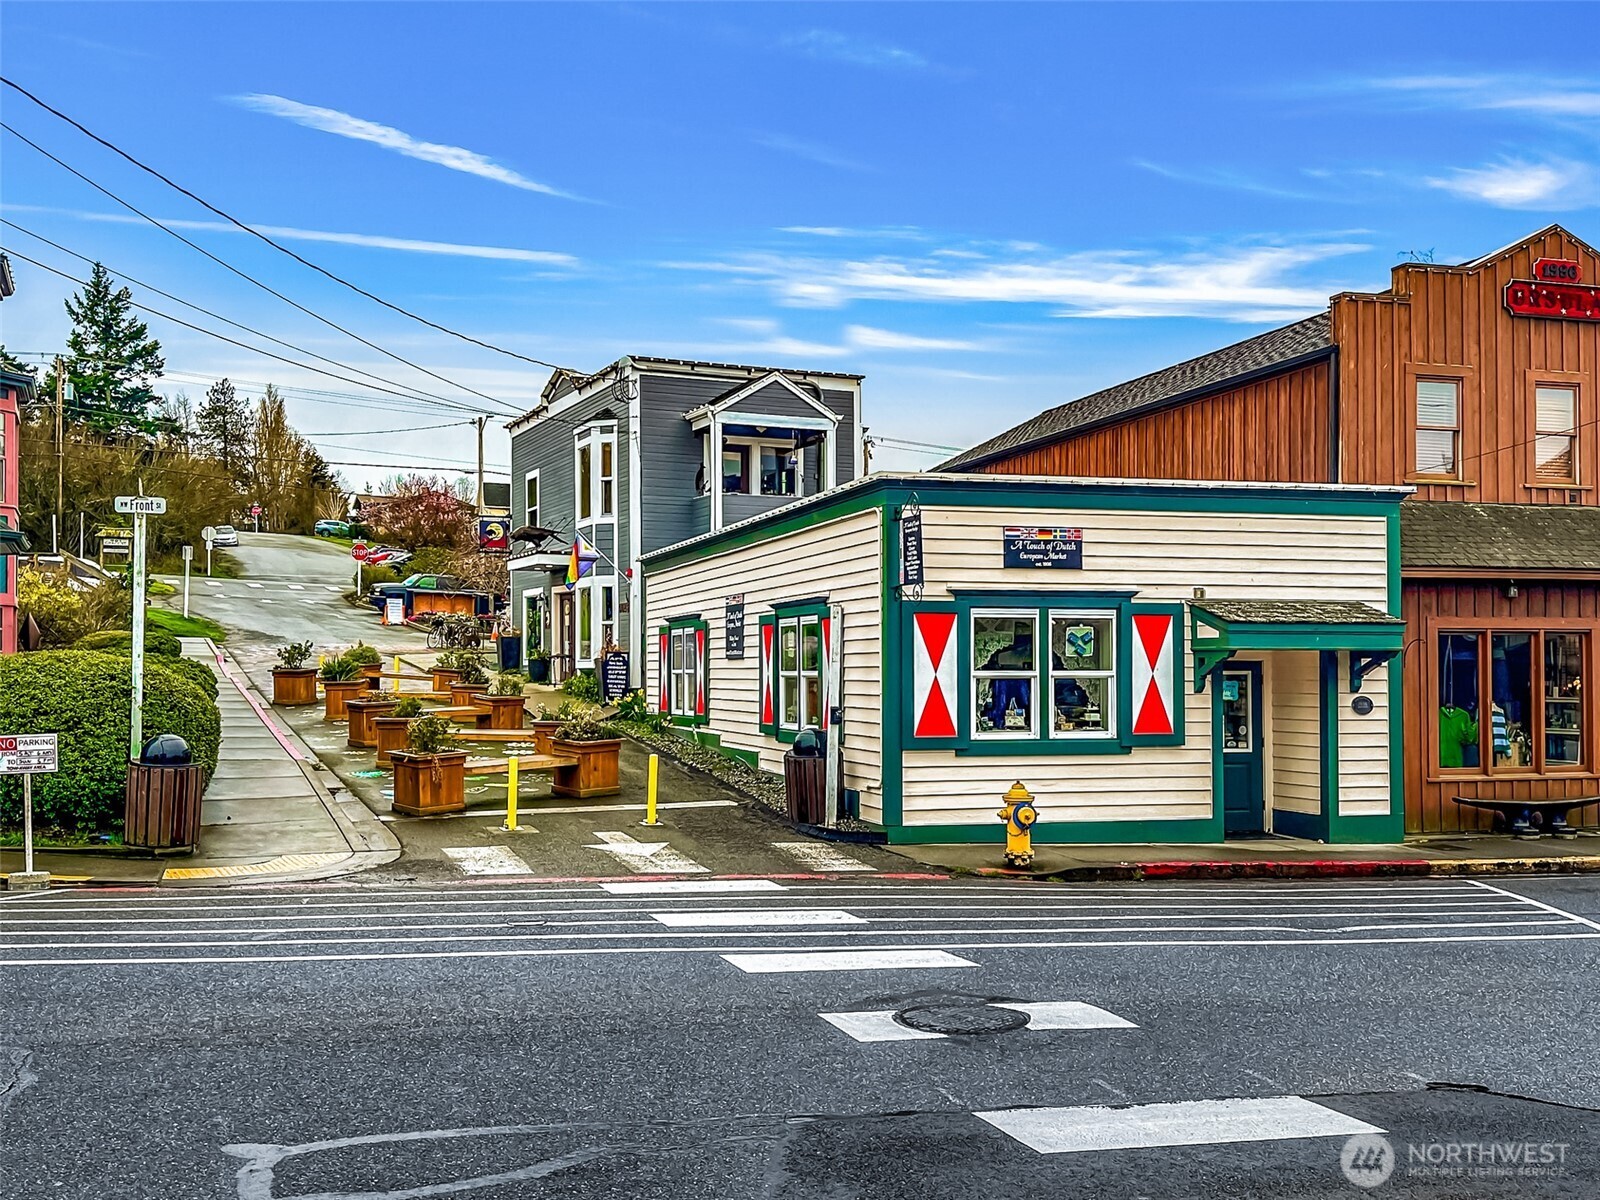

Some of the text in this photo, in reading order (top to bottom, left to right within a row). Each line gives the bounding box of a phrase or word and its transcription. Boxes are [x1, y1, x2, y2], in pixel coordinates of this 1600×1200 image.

[130, 499, 154, 511] Front
[1011, 541, 1076, 552] A Touch of Dutch
[1020, 552, 1067, 561] European Market
[0, 738, 54, 749] NO PARKING
